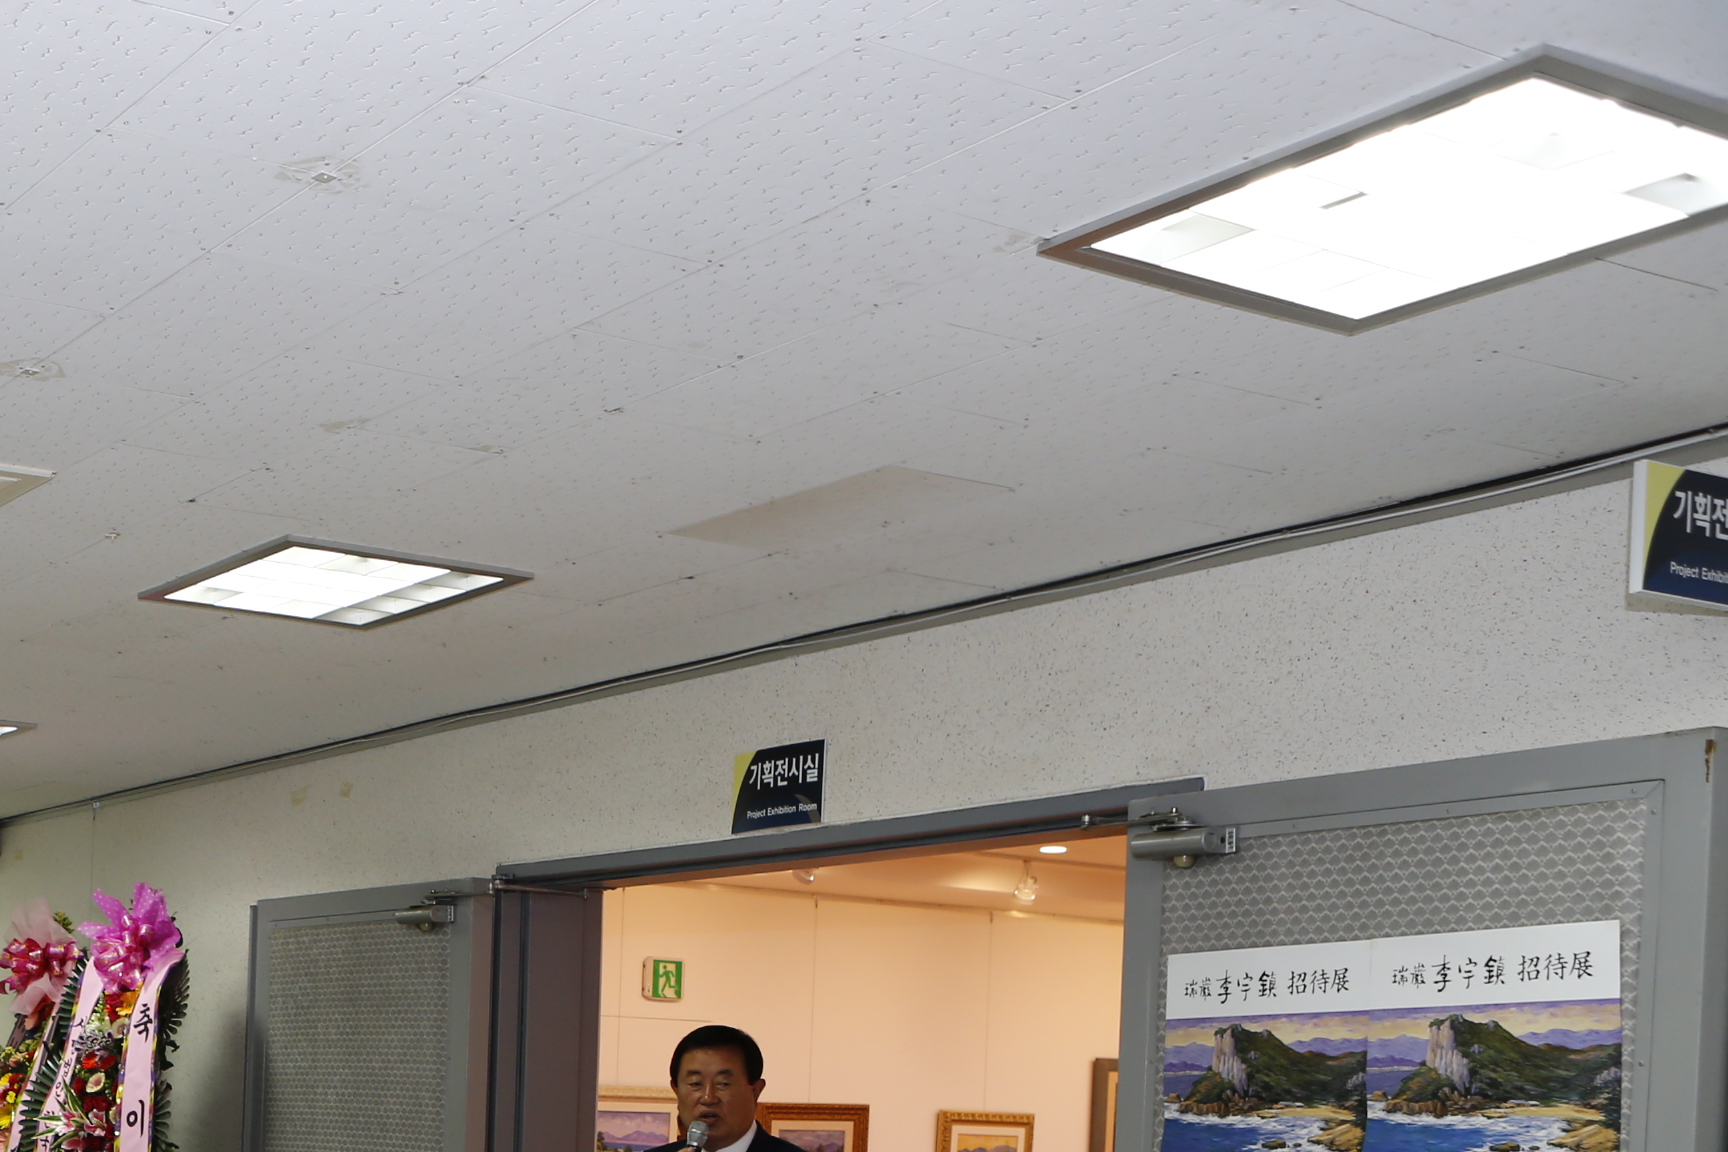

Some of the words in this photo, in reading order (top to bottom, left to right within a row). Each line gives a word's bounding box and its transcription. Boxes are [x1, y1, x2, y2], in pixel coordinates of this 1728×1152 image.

[1670, 562, 1699, 579] Project
[749, 753, 819, 790] 기획전시실
[746, 808, 766, 819] Project
[767, 804, 797, 816] Exhibition
[798, 803, 818, 812] Room
[1287, 967, 1349, 995] 招待展
[1517, 950, 1593, 982] 招待展
[133, 1003, 153, 1043] 축
